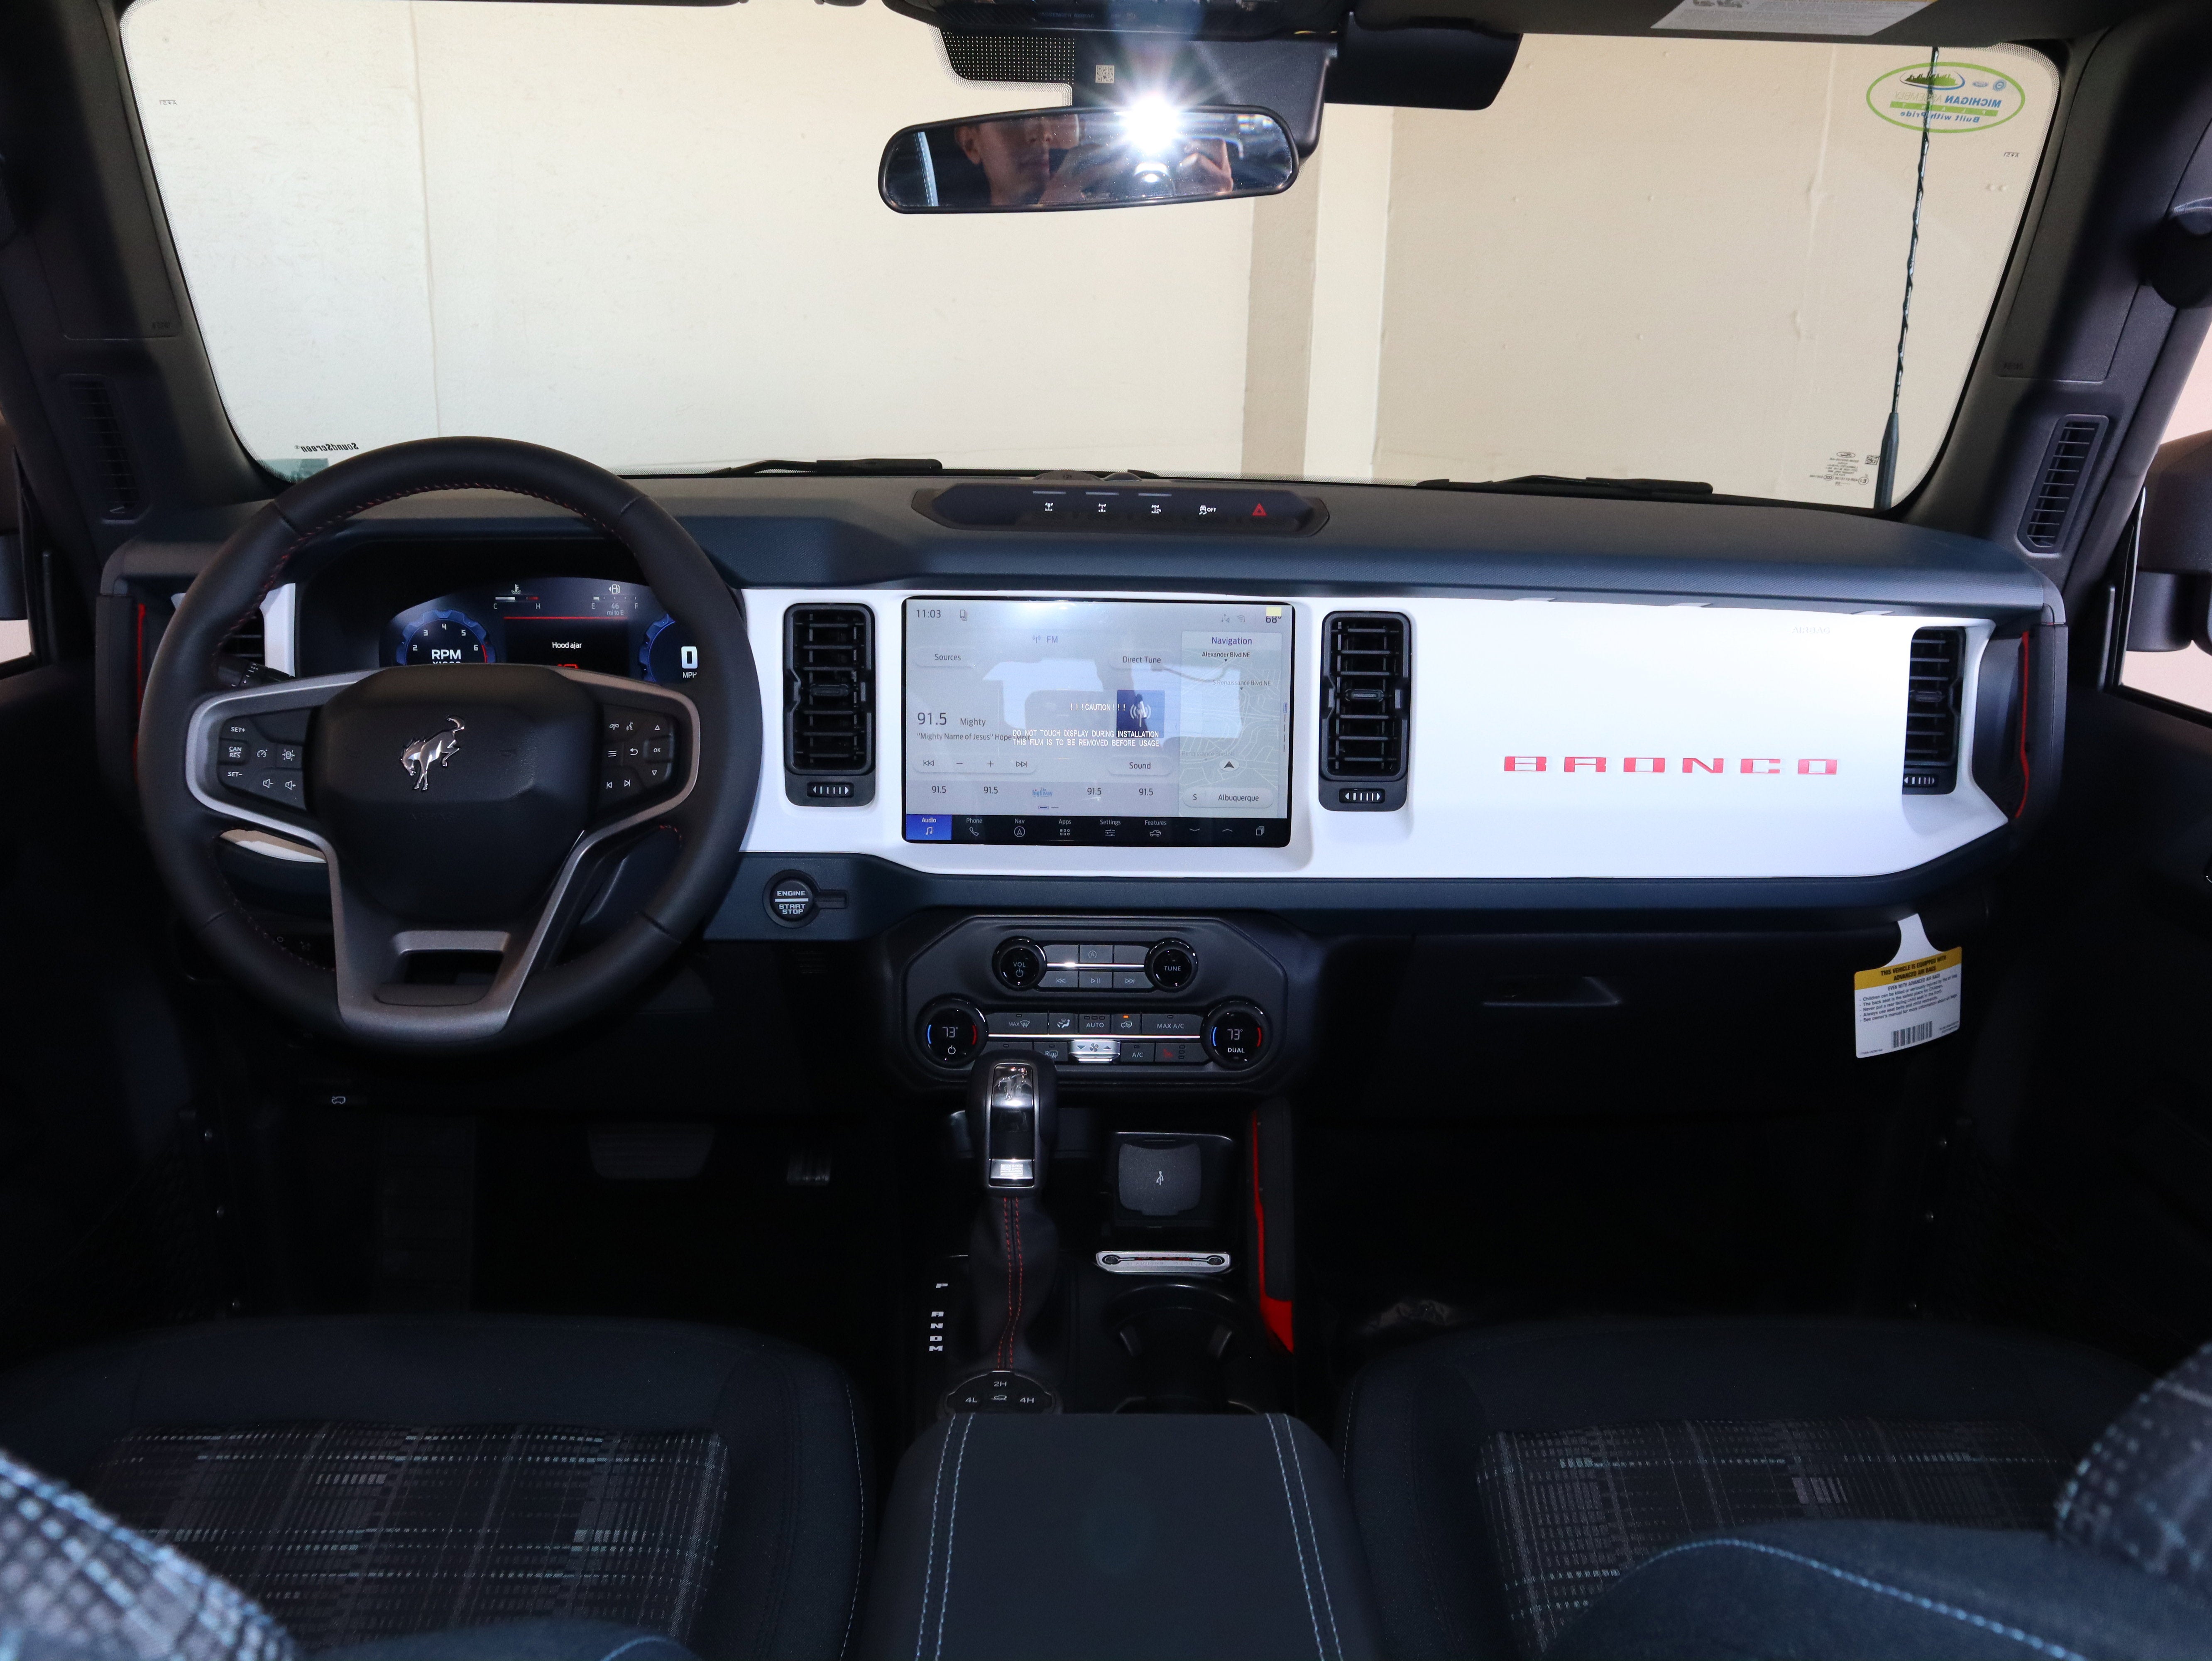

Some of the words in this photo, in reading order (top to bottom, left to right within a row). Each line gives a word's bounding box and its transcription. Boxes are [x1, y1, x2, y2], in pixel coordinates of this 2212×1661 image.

[916, 609, 941, 618] 11:03
[1211, 637, 1252, 646] Navigation
[431, 649, 461, 660] RPM
[681, 646, 698, 669] 0
[918, 712, 947, 725] 91.5
[960, 718, 986, 727] Mighty
[1504, 756, 1838, 775] BRONCO
[942, 1026, 958, 1038] 73°
[1227, 1029, 1243, 1040] 73°
